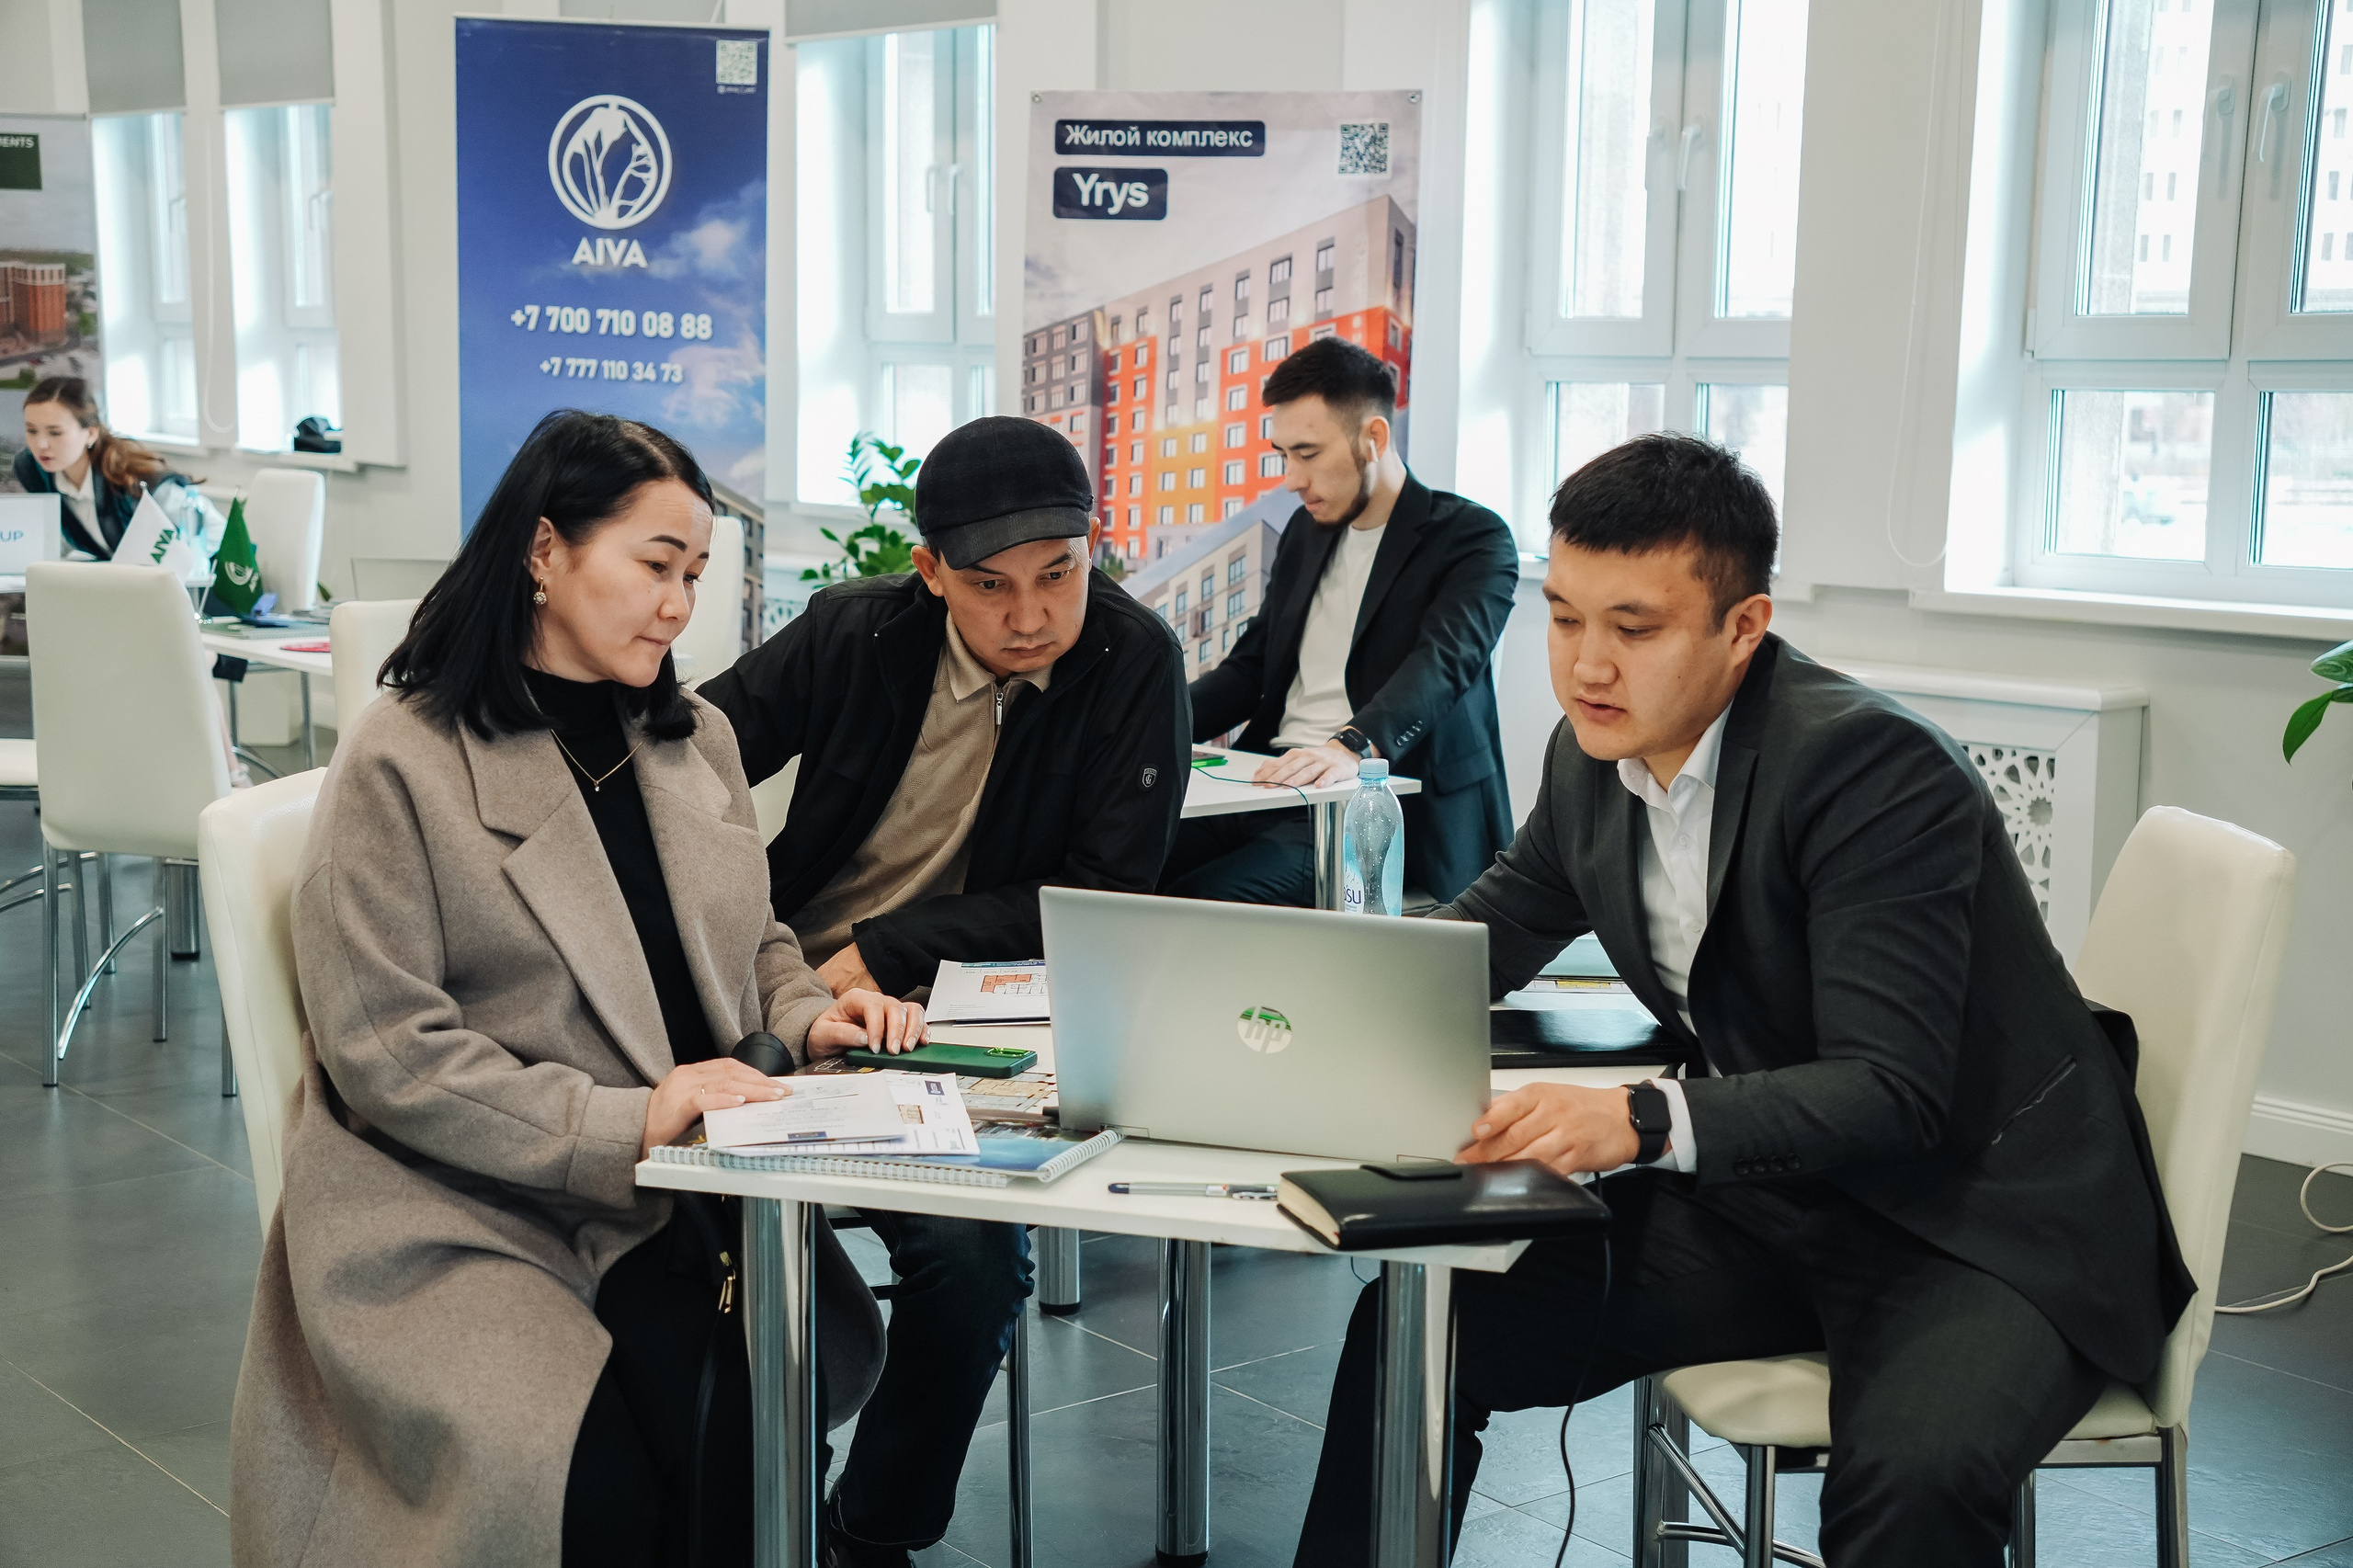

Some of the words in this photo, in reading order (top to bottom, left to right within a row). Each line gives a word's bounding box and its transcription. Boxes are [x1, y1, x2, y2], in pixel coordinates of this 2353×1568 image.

[1064, 124, 1141, 147] Жилой
[1146, 129, 1253, 148] комплекс
[1072, 173, 1149, 215] Yrys
[571, 236, 649, 268] AIVA
[510, 304, 540, 332] +7
[545, 305, 591, 335] 700
[596, 308, 637, 337] 710
[642, 311, 675, 339] 08
[680, 312, 713, 341] 88
[539, 356, 563, 378] +7
[565, 357, 598, 380] 777
[601, 359, 629, 381] 110
[631, 361, 657, 382] 34
[660, 363, 683, 384] 73
[150, 528, 175, 564] AIVA
[1242, 1006, 1289, 1053] hp
